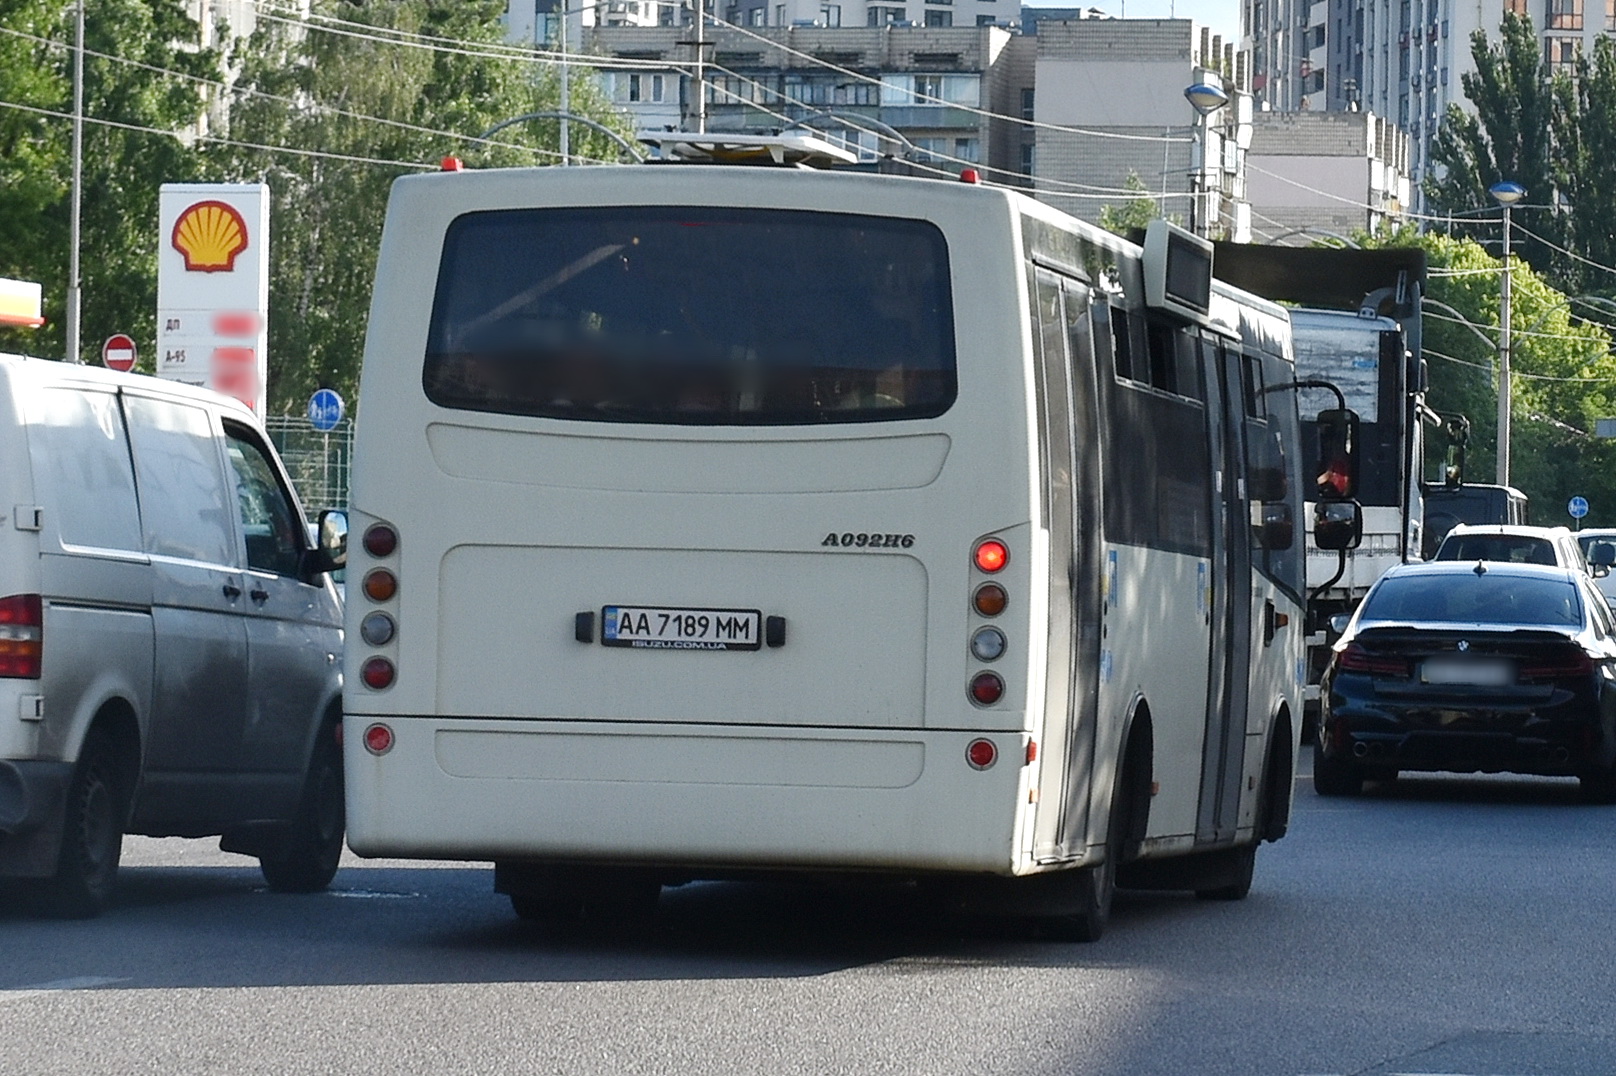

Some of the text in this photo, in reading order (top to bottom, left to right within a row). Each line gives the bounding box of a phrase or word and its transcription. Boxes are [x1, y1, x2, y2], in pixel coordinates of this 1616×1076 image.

[821, 532, 916, 548] A092H6
[618, 612, 750, 640] AA 7189 MM
[632, 640, 727, 650] ISUZU.COM.UA
